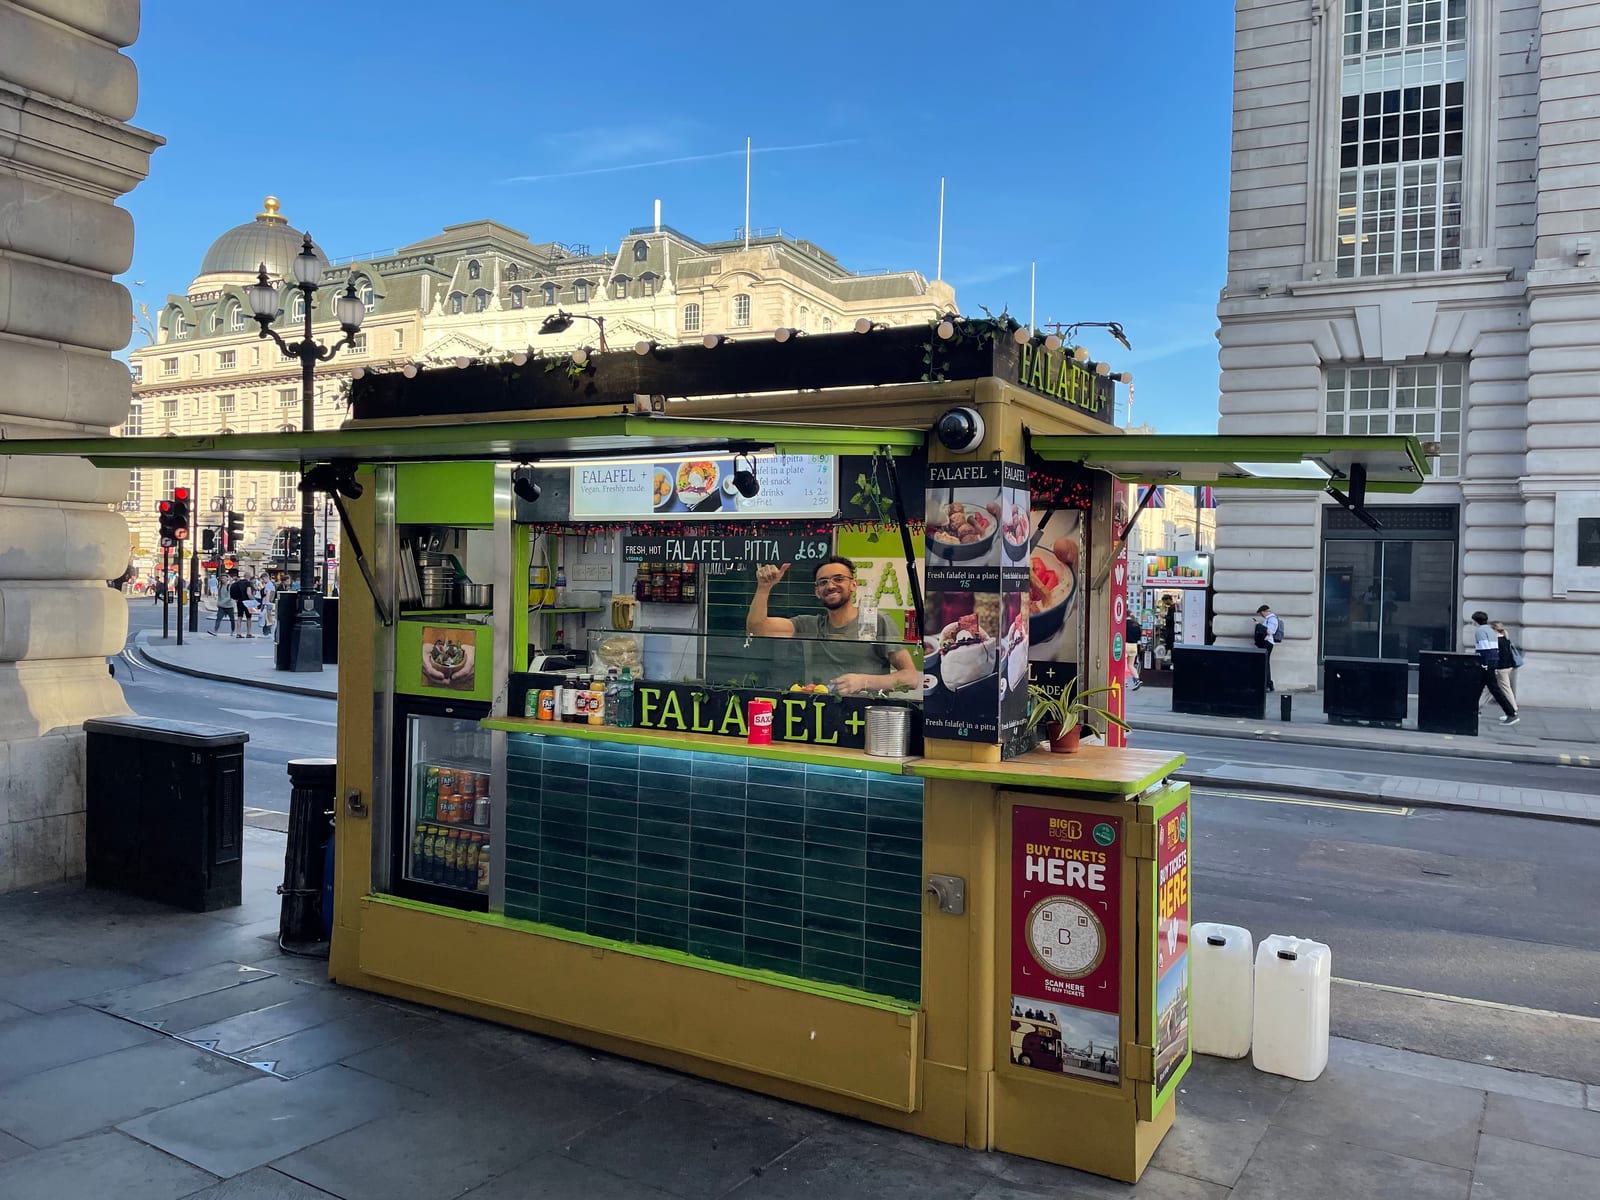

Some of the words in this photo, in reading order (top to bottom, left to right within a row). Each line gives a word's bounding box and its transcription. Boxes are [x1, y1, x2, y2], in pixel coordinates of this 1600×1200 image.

[1020, 342, 1098, 413] FALAFEL
[582, 469, 635, 484] FALAFEL
[770, 466, 778, 474] in
[780, 467, 784, 475] a
[786, 465, 804, 477] plate
[930, 467, 987, 481] FALAFEL
[1004, 466, 1026, 483] FALAFEL
[770, 477, 791, 485] snack
[602, 484, 626, 494] Freshly
[761, 487, 784, 496] drinks
[649, 545, 662, 555] HOT
[666, 539, 731, 561] FALAFEL
[744, 539, 780, 561] PITTA
[927, 572, 945, 580] Fresh
[946, 571, 967, 580] falafel
[968, 571, 975, 580] in
[983, 572, 999, 581] plate
[640, 687, 838, 744] FALAEL
[925, 718, 943, 728] Fresh
[944, 718, 965, 729] falafel
[966, 720, 973, 729] in
[974, 722, 979, 730] a
[980, 720, 996, 732] pitta
[1049, 817, 1068, 829] BIG
[1049, 828, 1068, 839] BUS
[1026, 843, 1051, 856] BUY
[1053, 847, 1106, 863] TICKETS
[1169, 848, 1187, 877] TICKETS
[1025, 855, 1106, 891] HERE
[1160, 866, 1187, 927] HERE
[1045, 978, 1064, 989] SCAN
[1065, 982, 1085, 993] HERE
[1052, 986, 1063, 994] BUY
[1064, 988, 1085, 998] TICKETS
